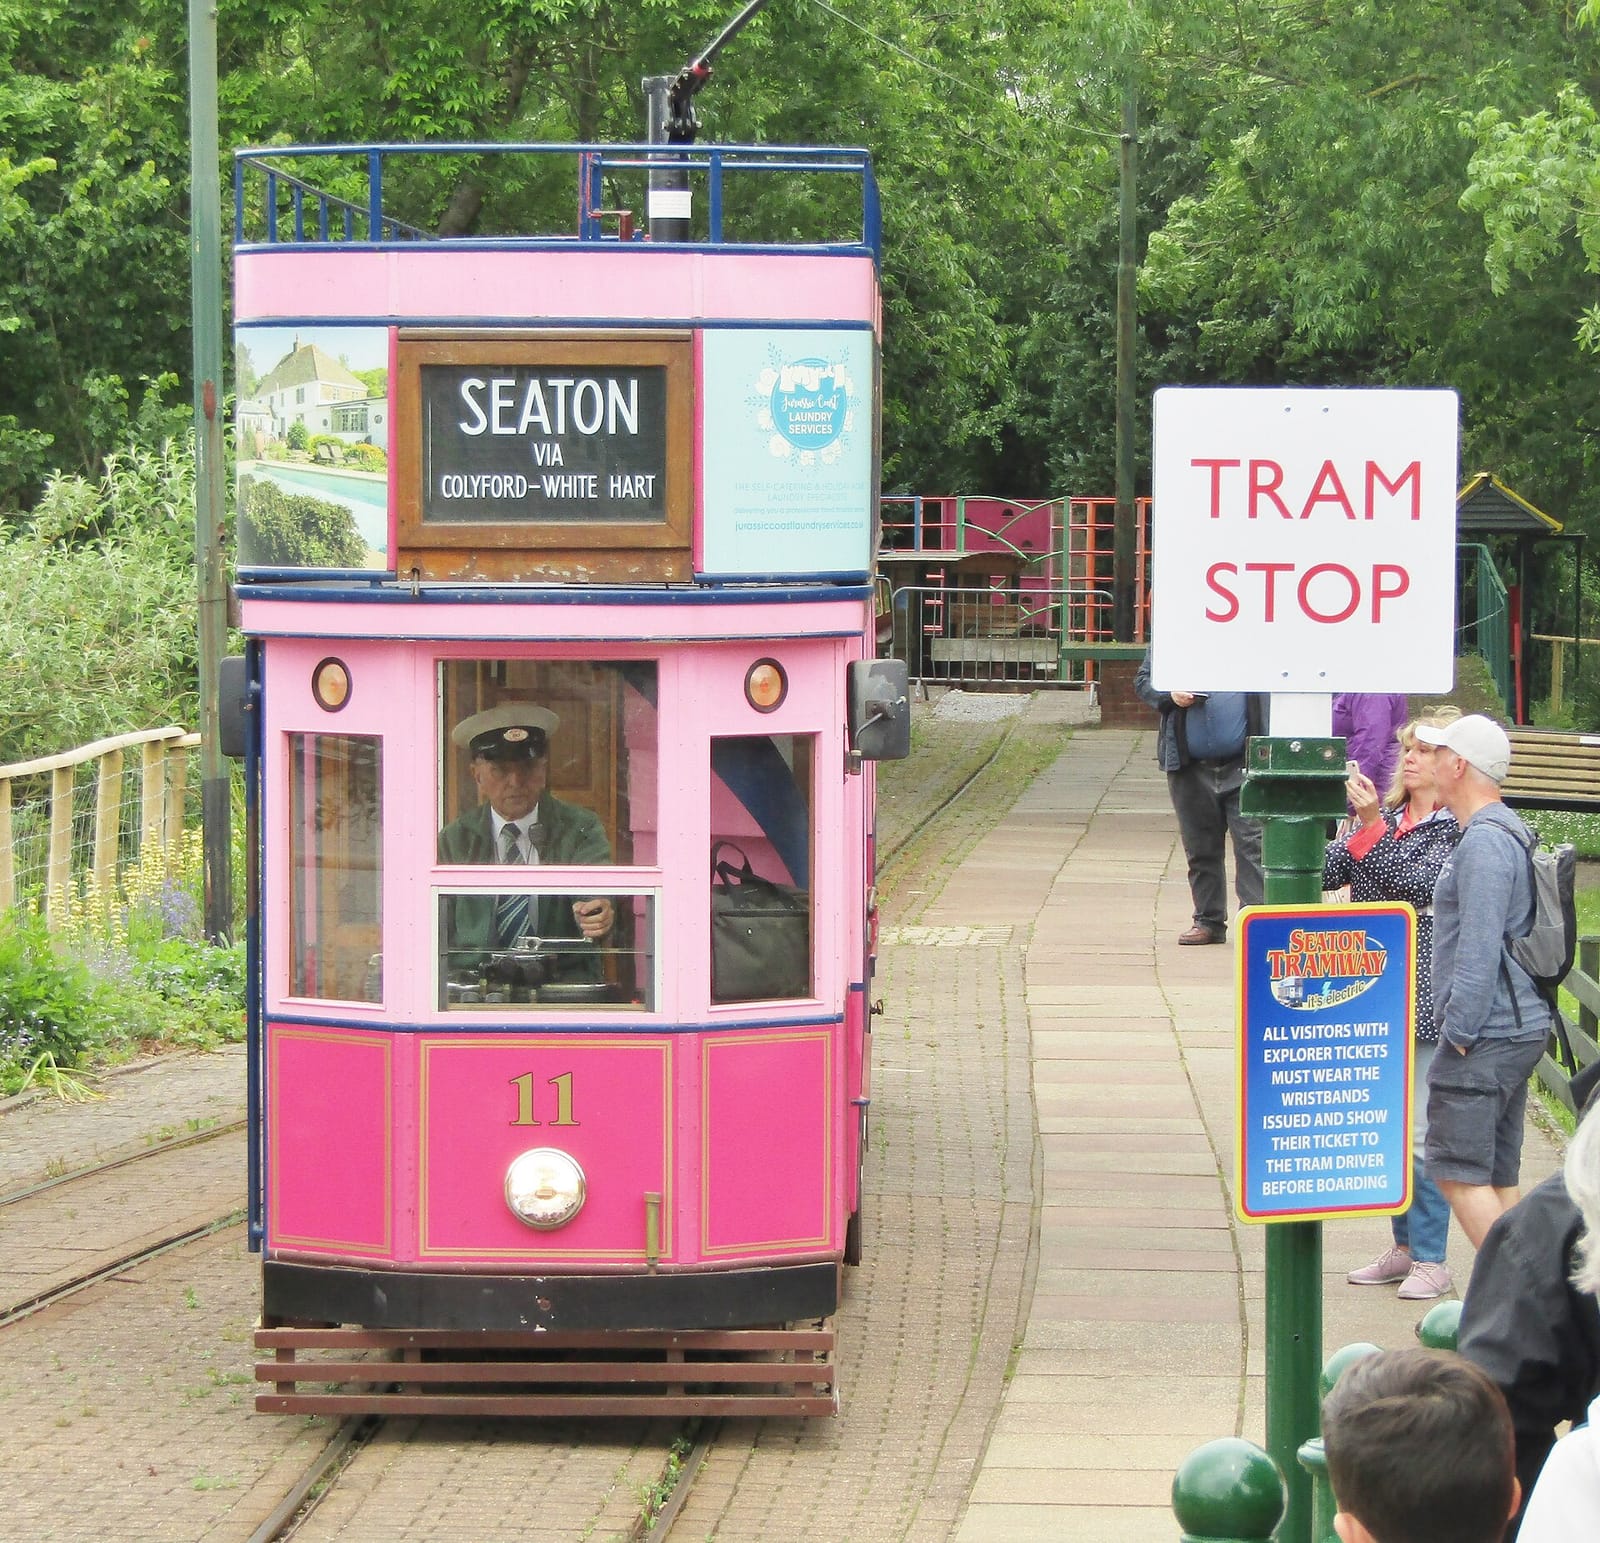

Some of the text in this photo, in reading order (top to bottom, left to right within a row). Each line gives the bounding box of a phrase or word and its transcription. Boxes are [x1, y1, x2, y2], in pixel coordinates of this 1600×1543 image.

[459, 378, 638, 436] SEATON
[788, 412, 833, 422] LAUNDRY
[788, 424, 833, 434] SERVICES
[533, 443, 565, 467] VIA
[609, 474, 656, 499] HART
[1190, 458, 1421, 521] TRAM
[1205, 561, 1410, 624] STOP
[1289, 928, 1366, 953] SEATON
[1267, 949, 1387, 979] TRAMWAY
[1307, 980, 1366, 1008] it's electric
[1263, 1022, 1388, 1042] ALL VISITORS WITH
[1263, 1044, 1388, 1063] EXPLORER TICKETS
[1271, 1066, 1380, 1085] MUST WEAR THE
[508, 1071, 581, 1126] 11
[1281, 1088, 1370, 1106] WRISTBANDS
[1263, 1109, 1388, 1129] ISSUED AND SHOW
[1272, 1132, 1379, 1151] THEIR TICKET TO
[1266, 1153, 1384, 1173] THE TRAM DRIVER
[1262, 1175, 1388, 1196] BEFORE BOARDING
